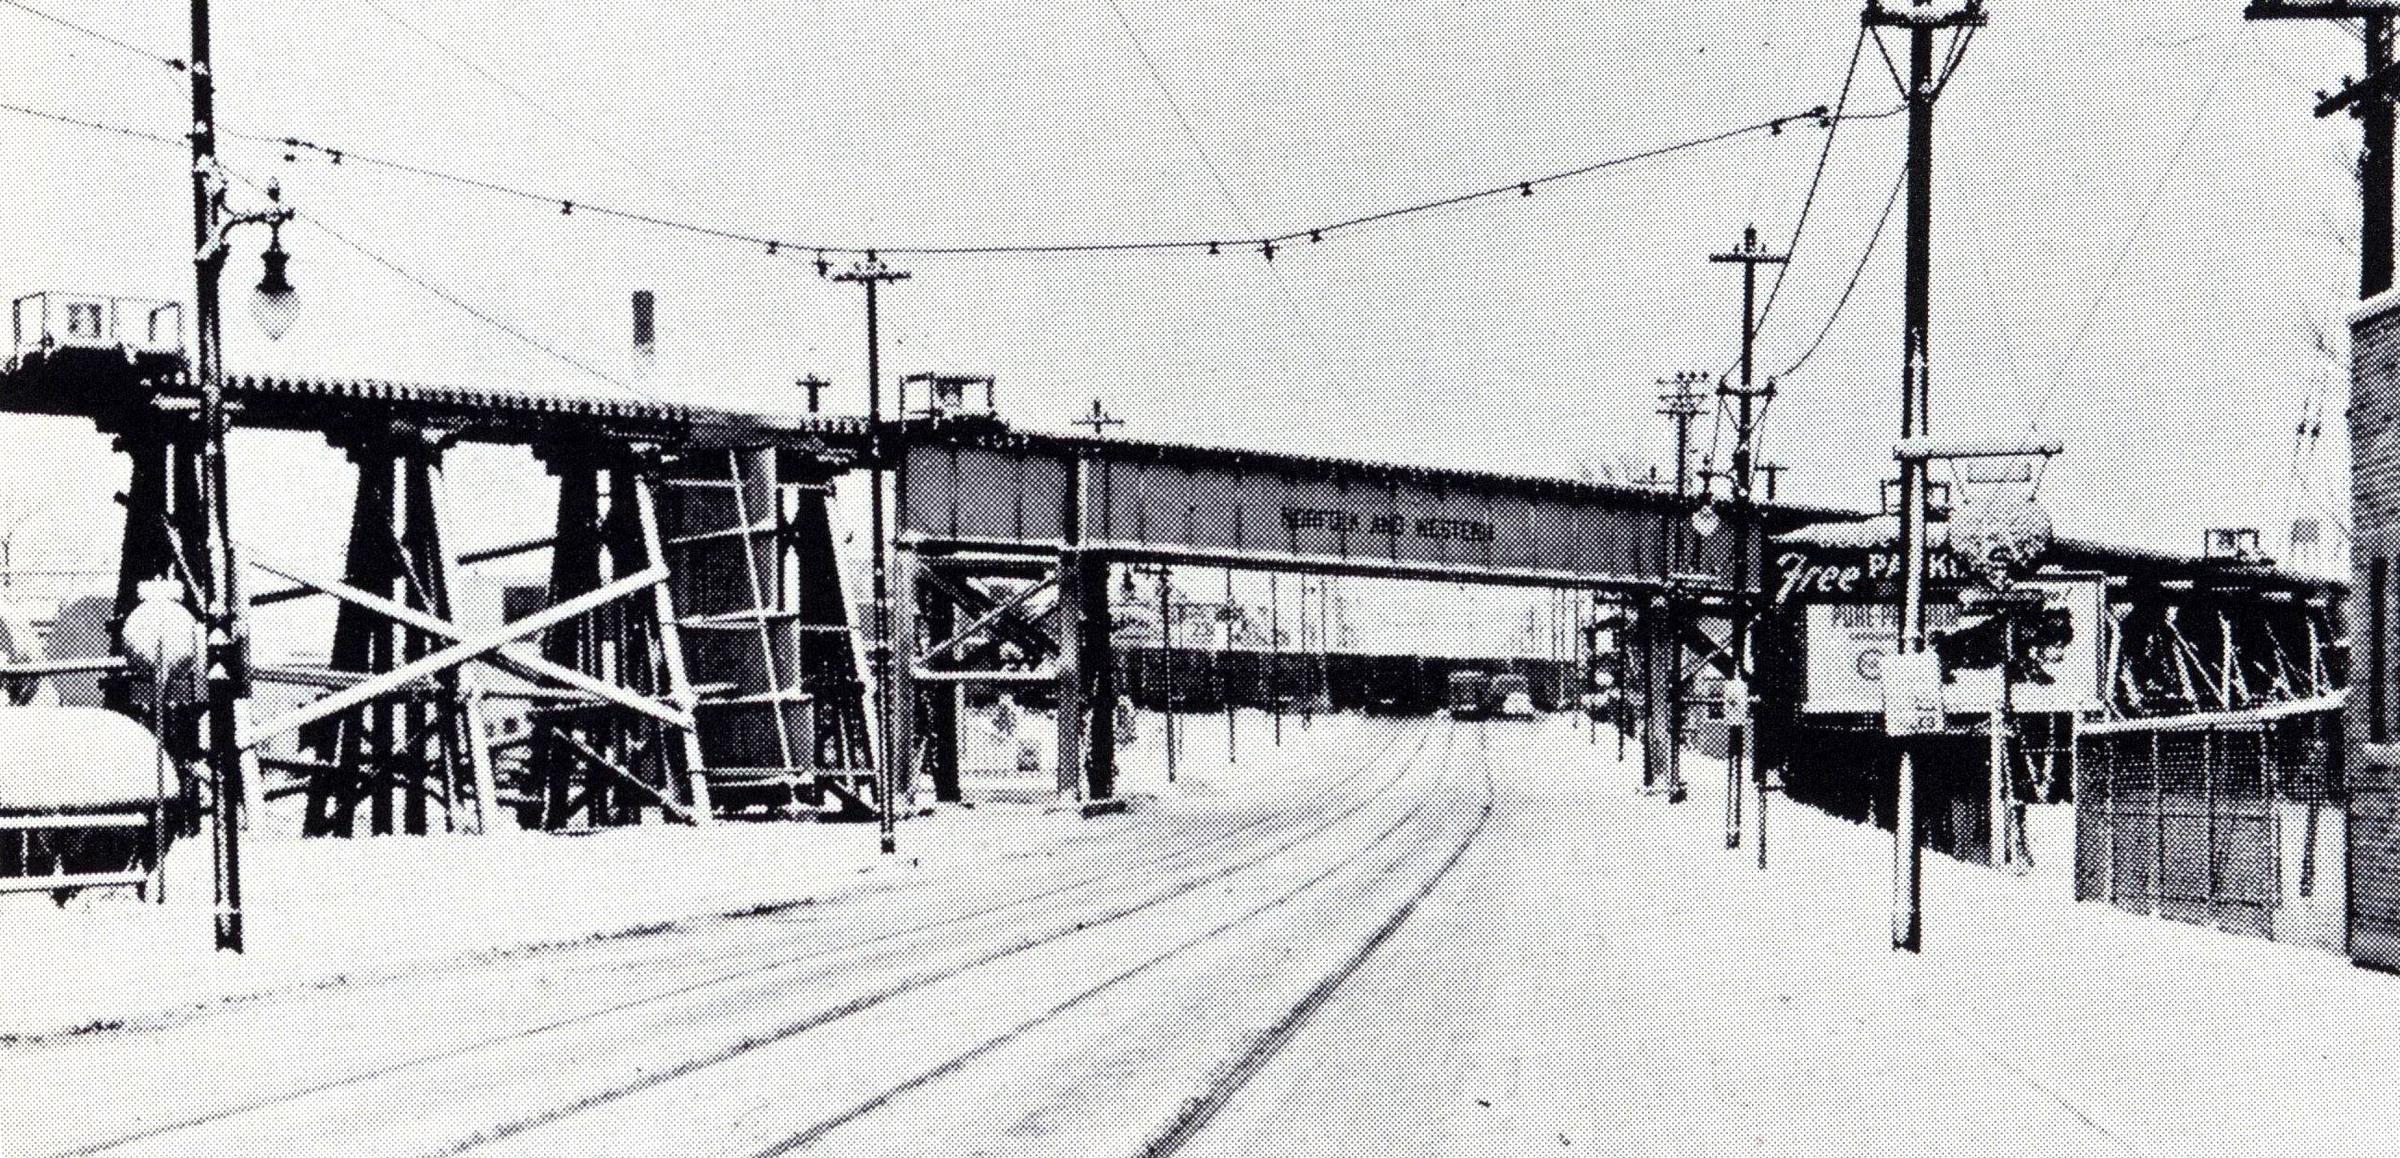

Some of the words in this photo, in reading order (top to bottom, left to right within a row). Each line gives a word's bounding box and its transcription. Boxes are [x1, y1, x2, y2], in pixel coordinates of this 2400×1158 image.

[1369, 515, 1405, 536] AND
[1415, 518, 1495, 542] WESTERN
[1776, 552, 1861, 604] Free
